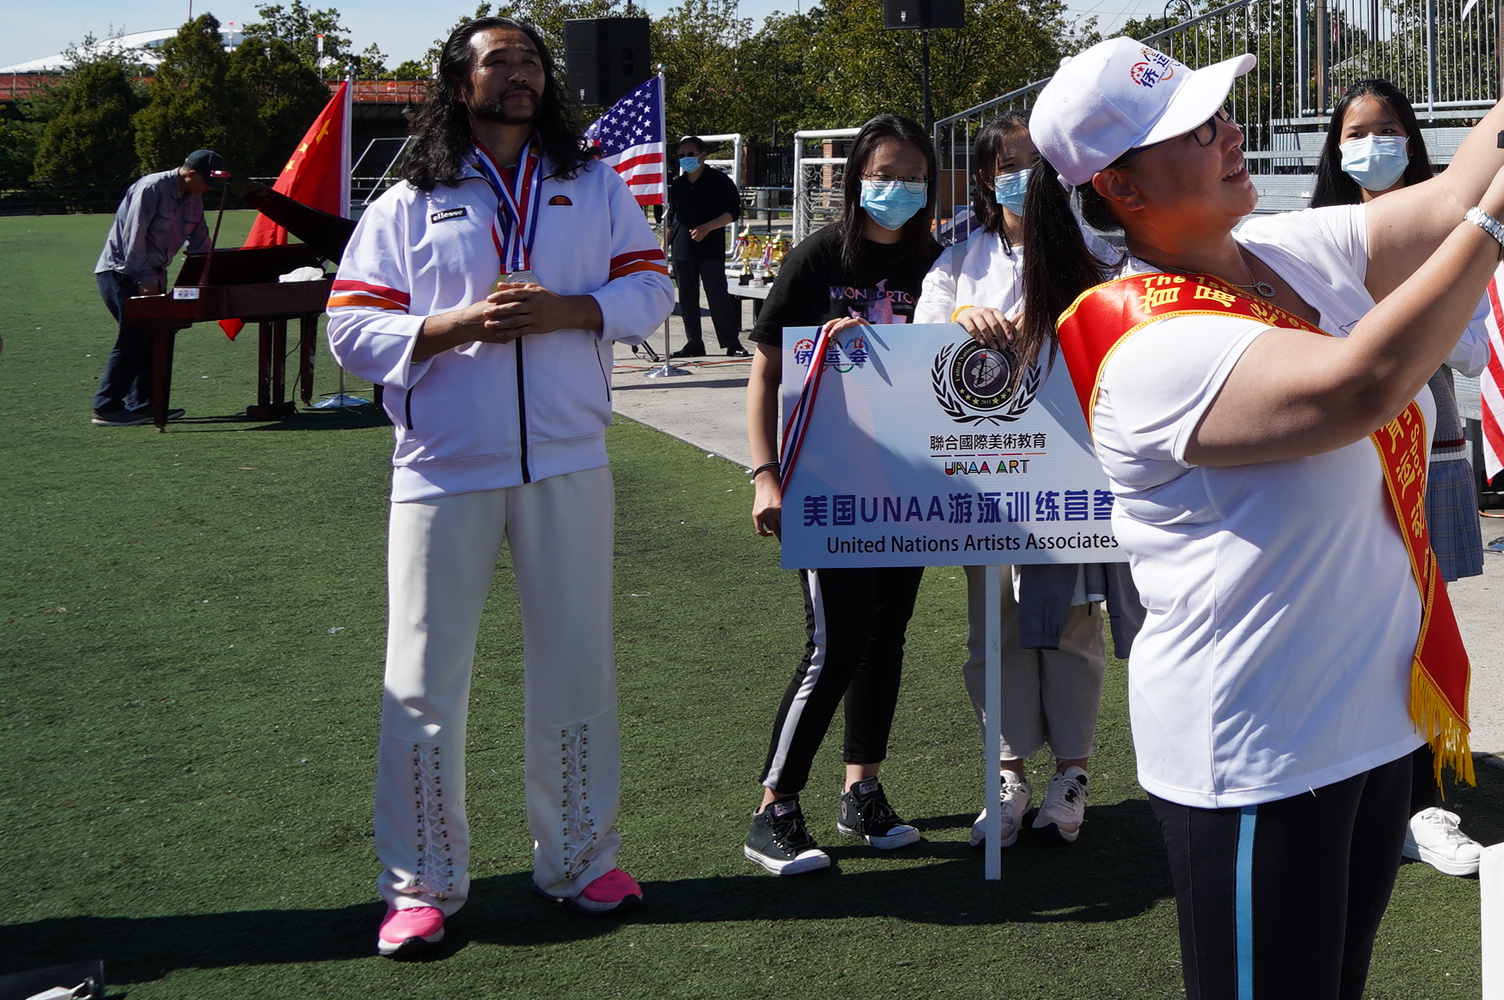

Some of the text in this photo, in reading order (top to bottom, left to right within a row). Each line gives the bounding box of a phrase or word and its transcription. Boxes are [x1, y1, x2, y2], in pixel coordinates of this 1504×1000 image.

[432, 209, 464, 221] ellesse
[1142, 275, 1187, 288] The
[929, 433, 1047, 451] 聯合國際美術教育
[995, 460, 1030, 474] ART
[827, 532, 1119, 553] United Nations Artists Associates
